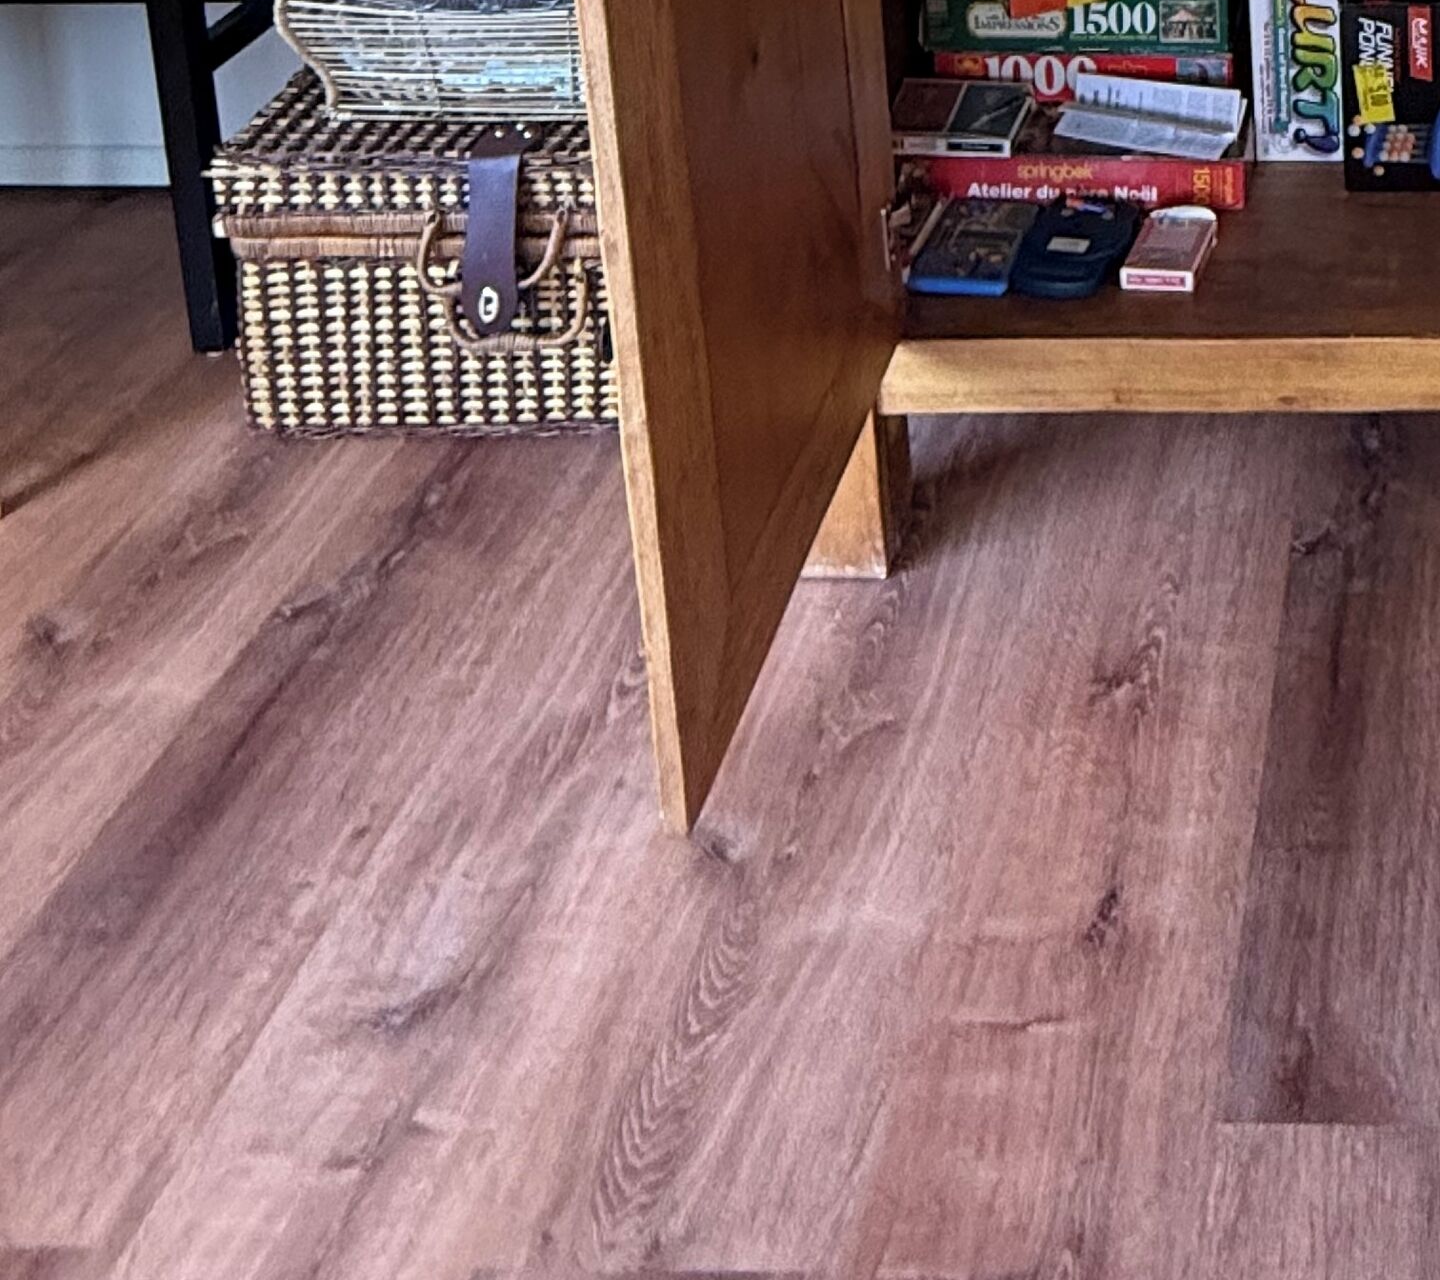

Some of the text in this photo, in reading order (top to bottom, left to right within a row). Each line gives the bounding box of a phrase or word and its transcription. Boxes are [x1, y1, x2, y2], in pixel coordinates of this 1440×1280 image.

[1072, 2, 1156, 35] 1500
[1375, 20, 1394, 93] FUNN
[967, 182, 1029, 200] Atelier
[1037, 184, 1060, 200] du
[1114, 183, 1157, 202] Noël
